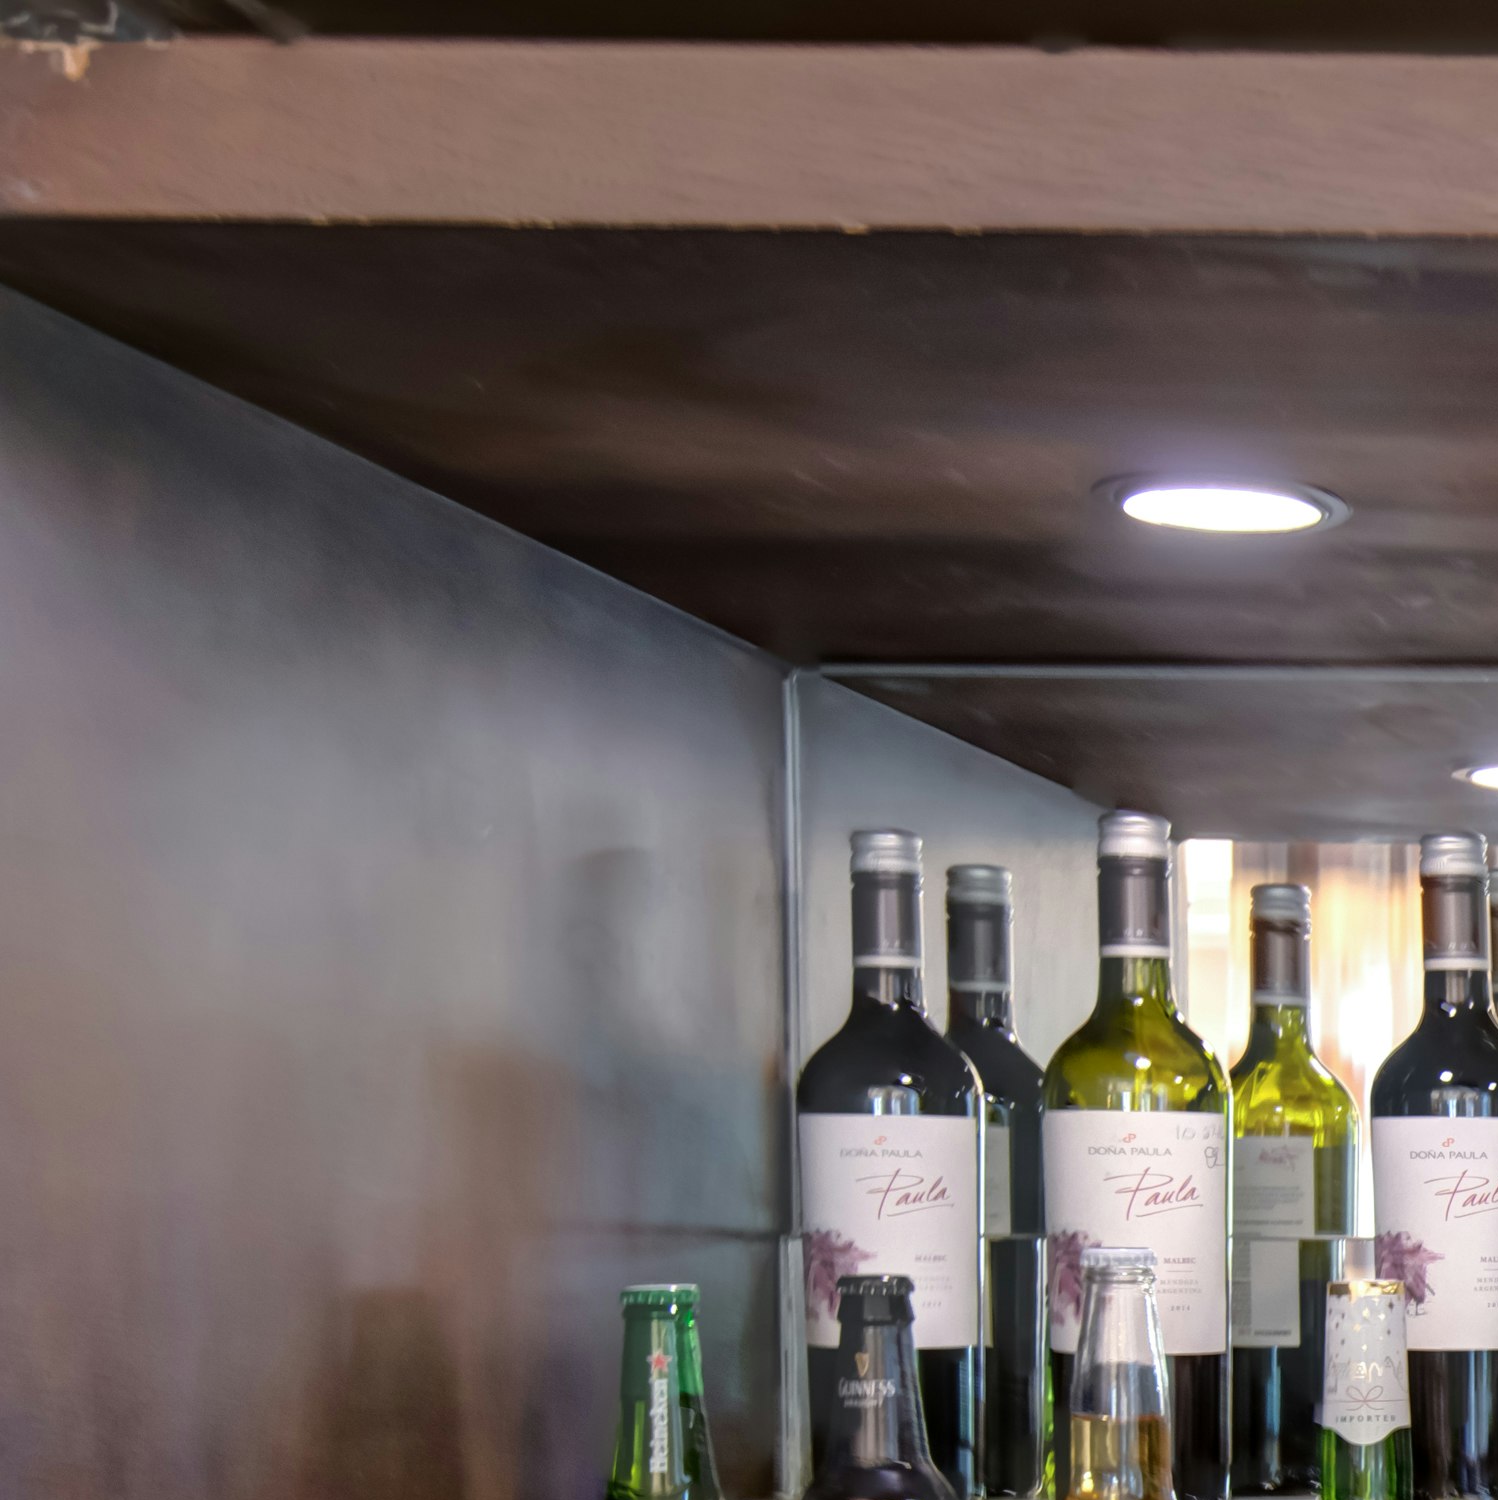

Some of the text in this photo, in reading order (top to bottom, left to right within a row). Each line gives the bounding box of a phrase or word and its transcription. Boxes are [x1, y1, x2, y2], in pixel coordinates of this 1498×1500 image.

[882, 1148, 923, 1158] PAULA
[1088, 1144, 1172, 1157] DOÑA PAULA
[1410, 1149, 1488, 1160] DOÑA PAULA
[856, 1169, 952, 1220] Paula
[1104, 1168, 1201, 1220] Paula
[1163, 1257, 1196, 1265] MALBEC
[839, 1378, 895, 1397] GUINNESS
[648, 1378, 669, 1474] Heineken
